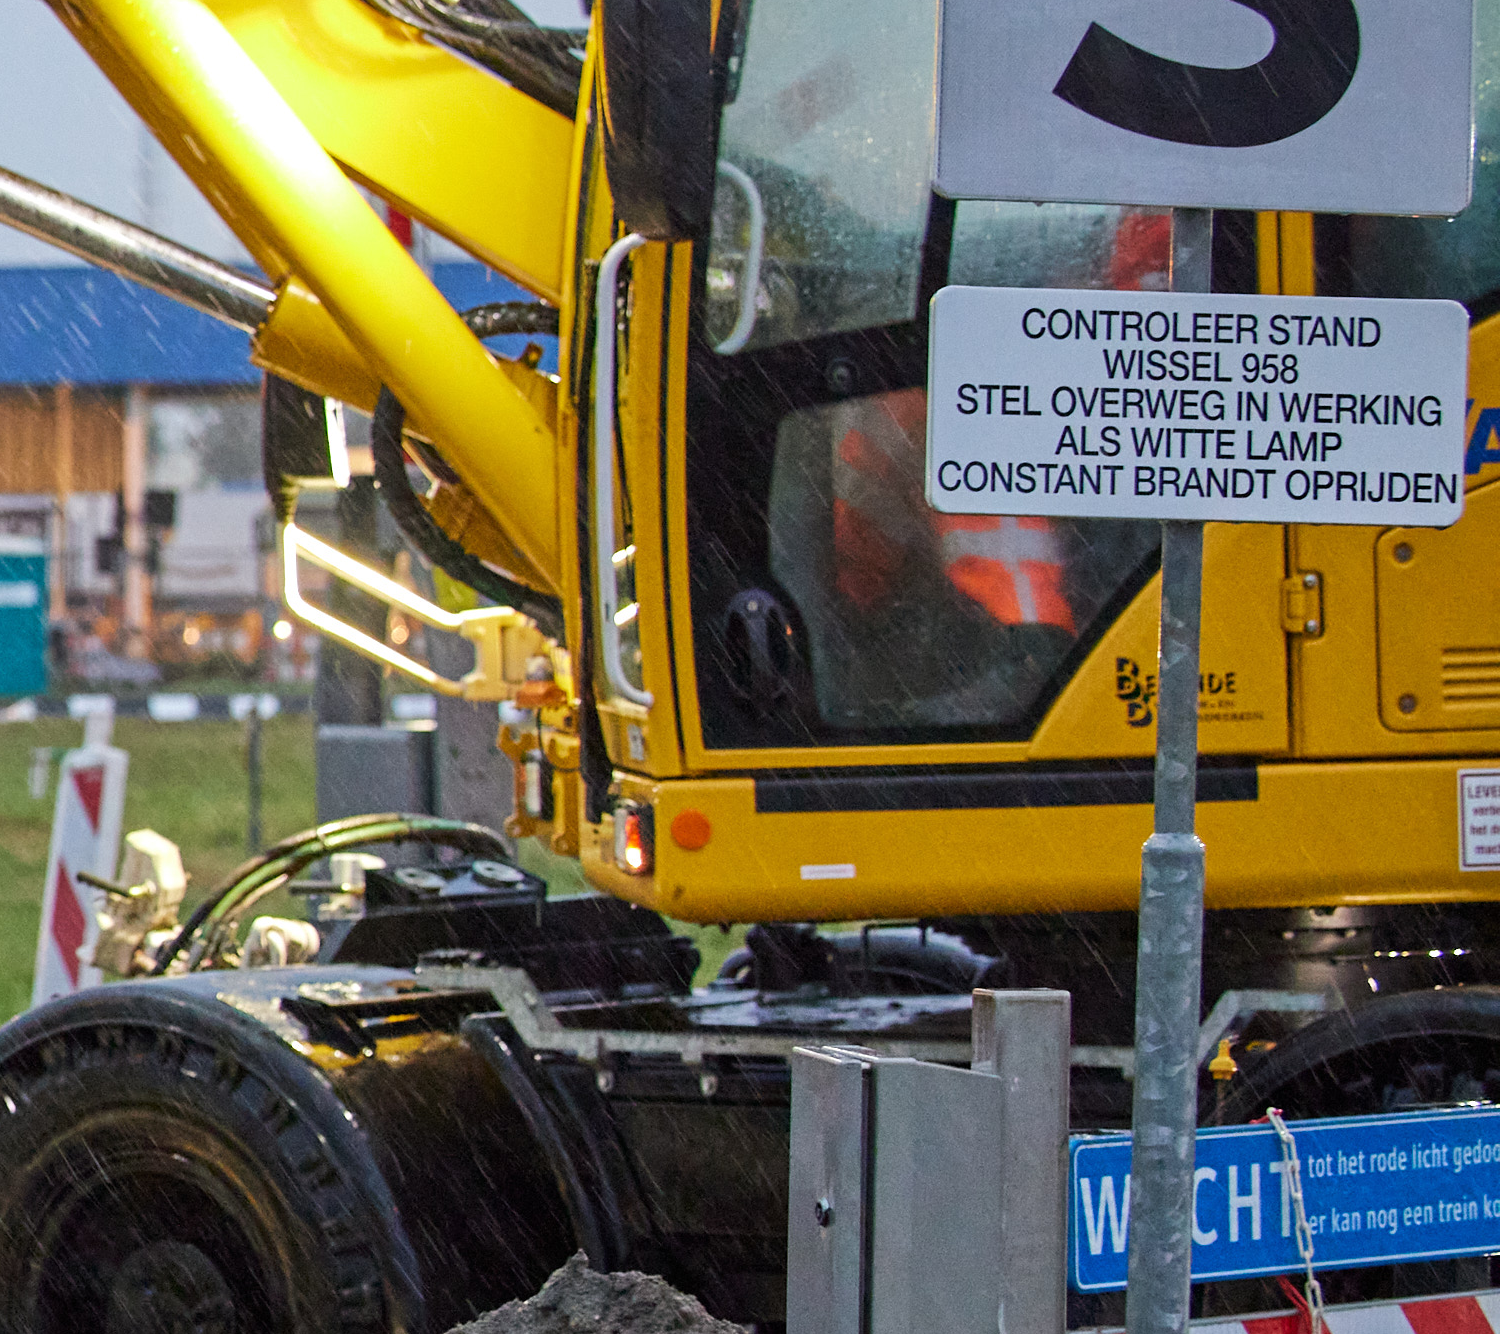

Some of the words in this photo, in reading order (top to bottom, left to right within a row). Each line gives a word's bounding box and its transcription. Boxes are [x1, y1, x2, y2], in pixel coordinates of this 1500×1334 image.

[1021, 307, 1258, 345] CONTROLEER
[1268, 314, 1381, 348] STAND
[1102, 349, 1232, 383] WISSEL
[1241, 353, 1299, 385] 958
[956, 384, 1041, 418] STEL
[1050, 387, 1225, 422] OVERWEG
[1236, 391, 1269, 422] IN
[1279, 392, 1442, 427] WERKING
[1054, 425, 1121, 457] ALS
[1131, 427, 1236, 460] WITTE
[1246, 431, 1342, 462] LAMP
[937, 460, 1124, 496] CONSTANT
[1133, 467, 1276, 501] BRANDT
[1285, 471, 1458, 505] OPRIJDEN
[1080, 1160, 1299, 1256] WCHT
[1308, 1153, 1334, 1178] tot
[1338, 1150, 1366, 1176] het
[1370, 1146, 1407, 1173] rode
[1412, 1142, 1449, 1169] licht
[1308, 1214, 1326, 1235] er
[1331, 1207, 1362, 1234] kan
[1366, 1208, 1398, 1235] nog
[1403, 1205, 1434, 1226] een
[1439, 1195, 1479, 1223] trein
